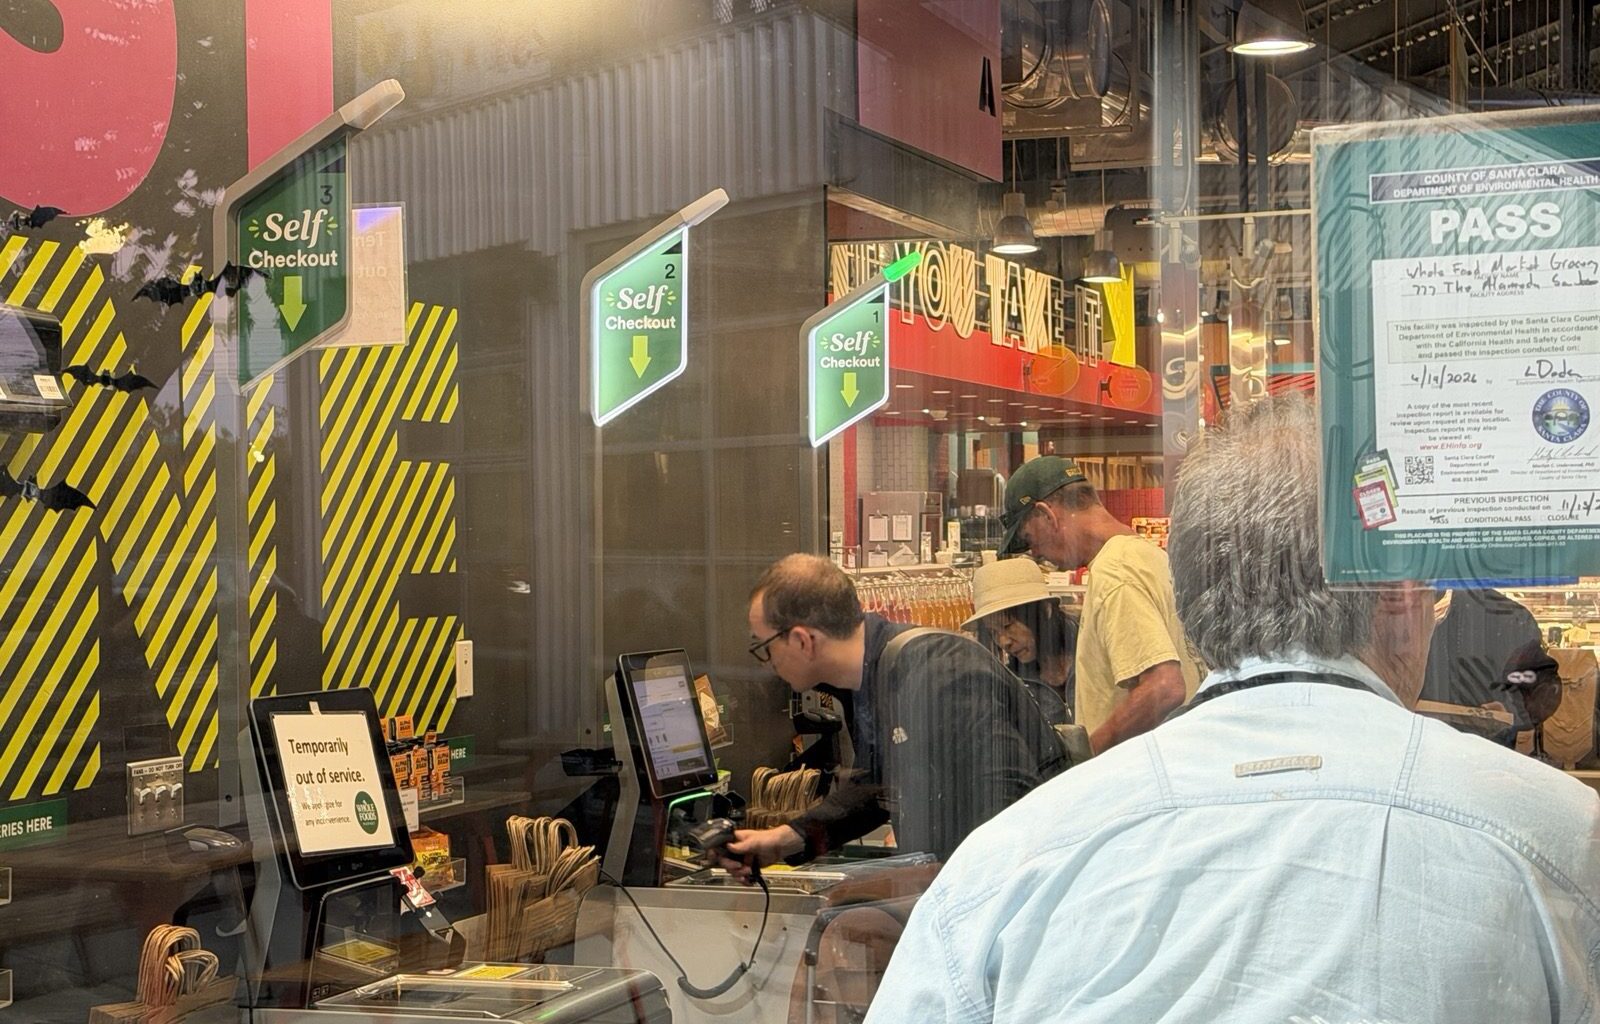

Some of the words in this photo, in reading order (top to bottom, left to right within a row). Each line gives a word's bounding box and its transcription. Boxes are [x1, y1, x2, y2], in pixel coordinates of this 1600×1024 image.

[1424, 172, 1468, 185] COUNTY
[1471, 171, 1486, 182] OF
[1489, 168, 1526, 180] SANTA
[1528, 165, 1566, 176] CLARA
[320, 185, 332, 205] 3
[1393, 185, 1457, 198] DEPARTMENT
[1459, 183, 1472, 193] OF
[1475, 178, 1557, 192] ENVIRONMENTAL
[1559, 176, 1598, 186] HEALTH
[263, 209, 328, 248] Self
[1430, 201, 1562, 244] PASS
[249, 249, 337, 268] Checkout
[665, 263, 675, 279] 2
[1444, 281, 1472, 293] The
[617, 285, 668, 315] Self
[895, 240, 975, 339] YOU
[985, 254, 1065, 359] TAKE
[1074, 284, 1105, 368] IT
[605, 315, 676, 330] Checkout
[873, 310, 878, 323] 1
[1413, 323, 1439, 332] facility
[1458, 320, 1497, 330] inspected
[1500, 319, 1509, 328] by
[1525, 317, 1548, 325] Santa
[1550, 316, 1572, 324] Clara
[1399, 332, 1444, 341] Department
[1456, 328, 1512, 338] Environmental
[1552, 324, 1599, 333] accordance
[830, 331, 873, 356] Self
[1449, 338, 1486, 348] California
[1489, 337, 1514, 345] Health
[1533, 335, 1557, 344] Safety
[1434, 350, 1463, 359] passed
[1479, 347, 1520, 357] inspection
[1522, 345, 1564, 354] conducted
[820, 356, 880, 368] Checkout
[1547, 389, 1578, 400] COUNTY
[1538, 425, 1560, 443] SANTA
[1499, 495, 1550, 503] INSPECTION
[288, 738, 349, 757] Temporarily
[451, 748, 466, 759] HERE
[296, 771, 314, 785] out
[316, 768, 327, 783] of
[329, 768, 365, 783] service.
[356, 804, 375, 812] WHOLE
[359, 812, 377, 821] FOODS
[0, 821, 23, 838] RIES
[26, 816, 52, 833] HERE
